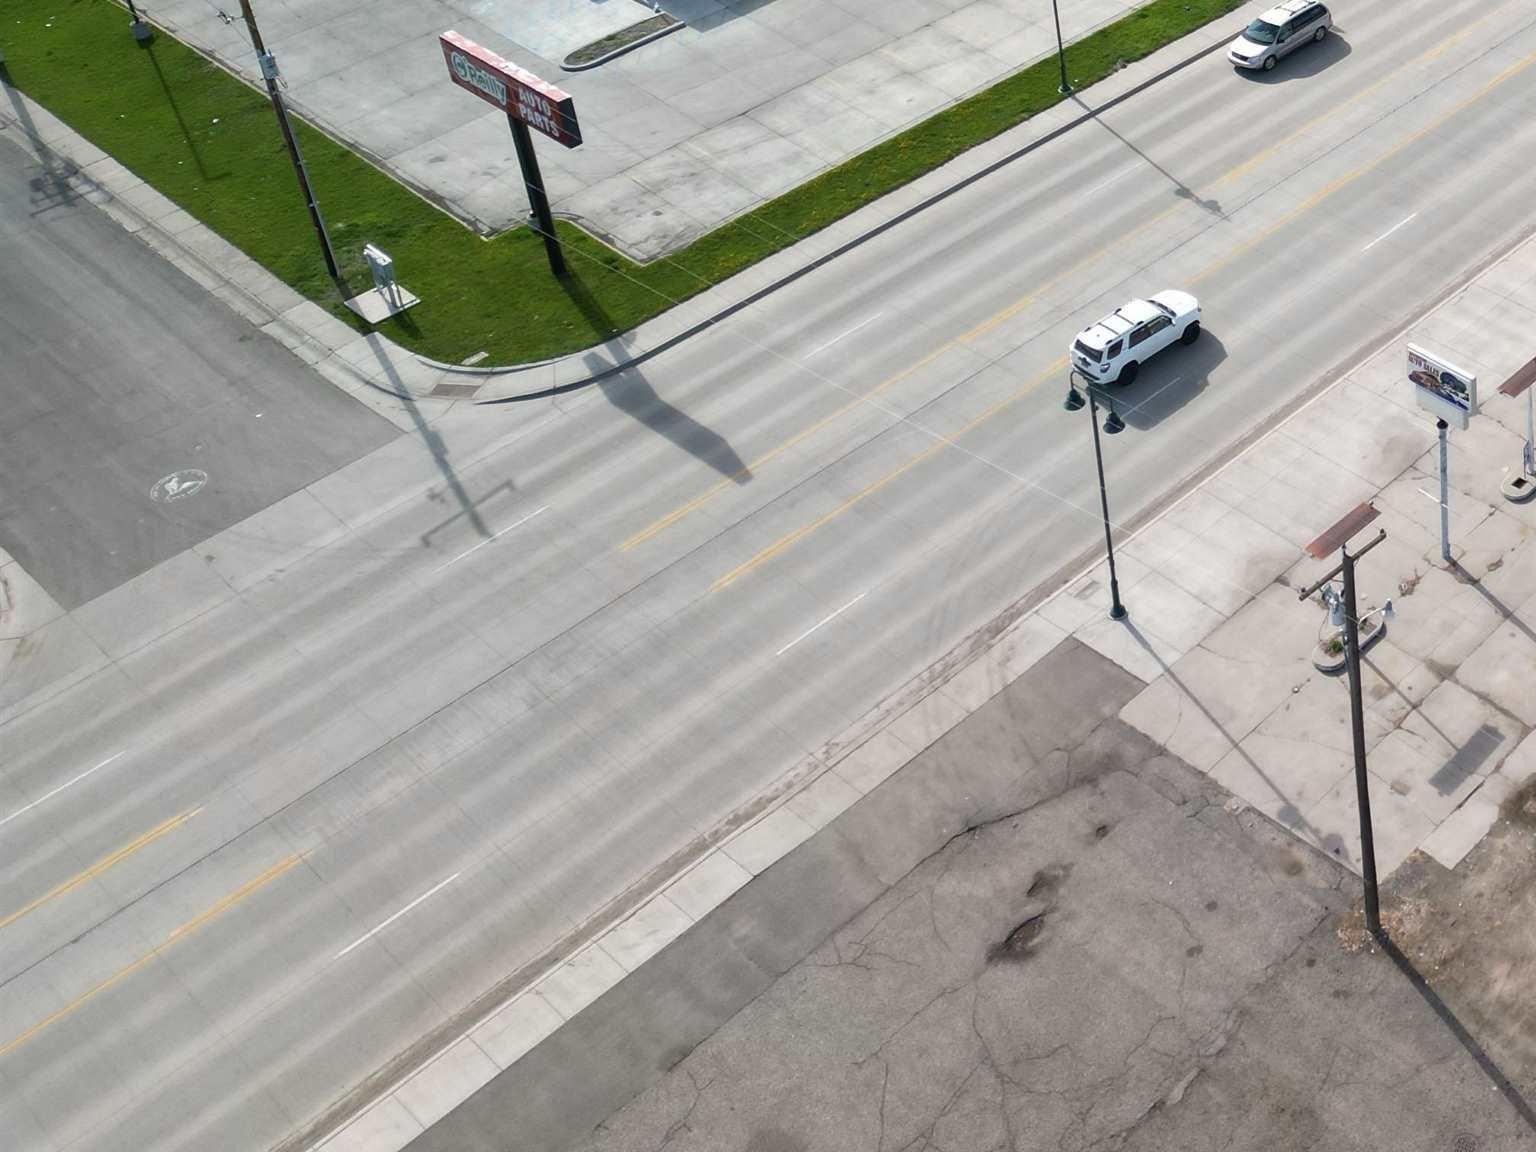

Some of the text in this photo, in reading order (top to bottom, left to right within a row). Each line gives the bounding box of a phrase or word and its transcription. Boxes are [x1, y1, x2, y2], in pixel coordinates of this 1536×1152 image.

[451, 51, 552, 116] O'Reilly AUTO
[518, 102, 560, 138] PARTS
